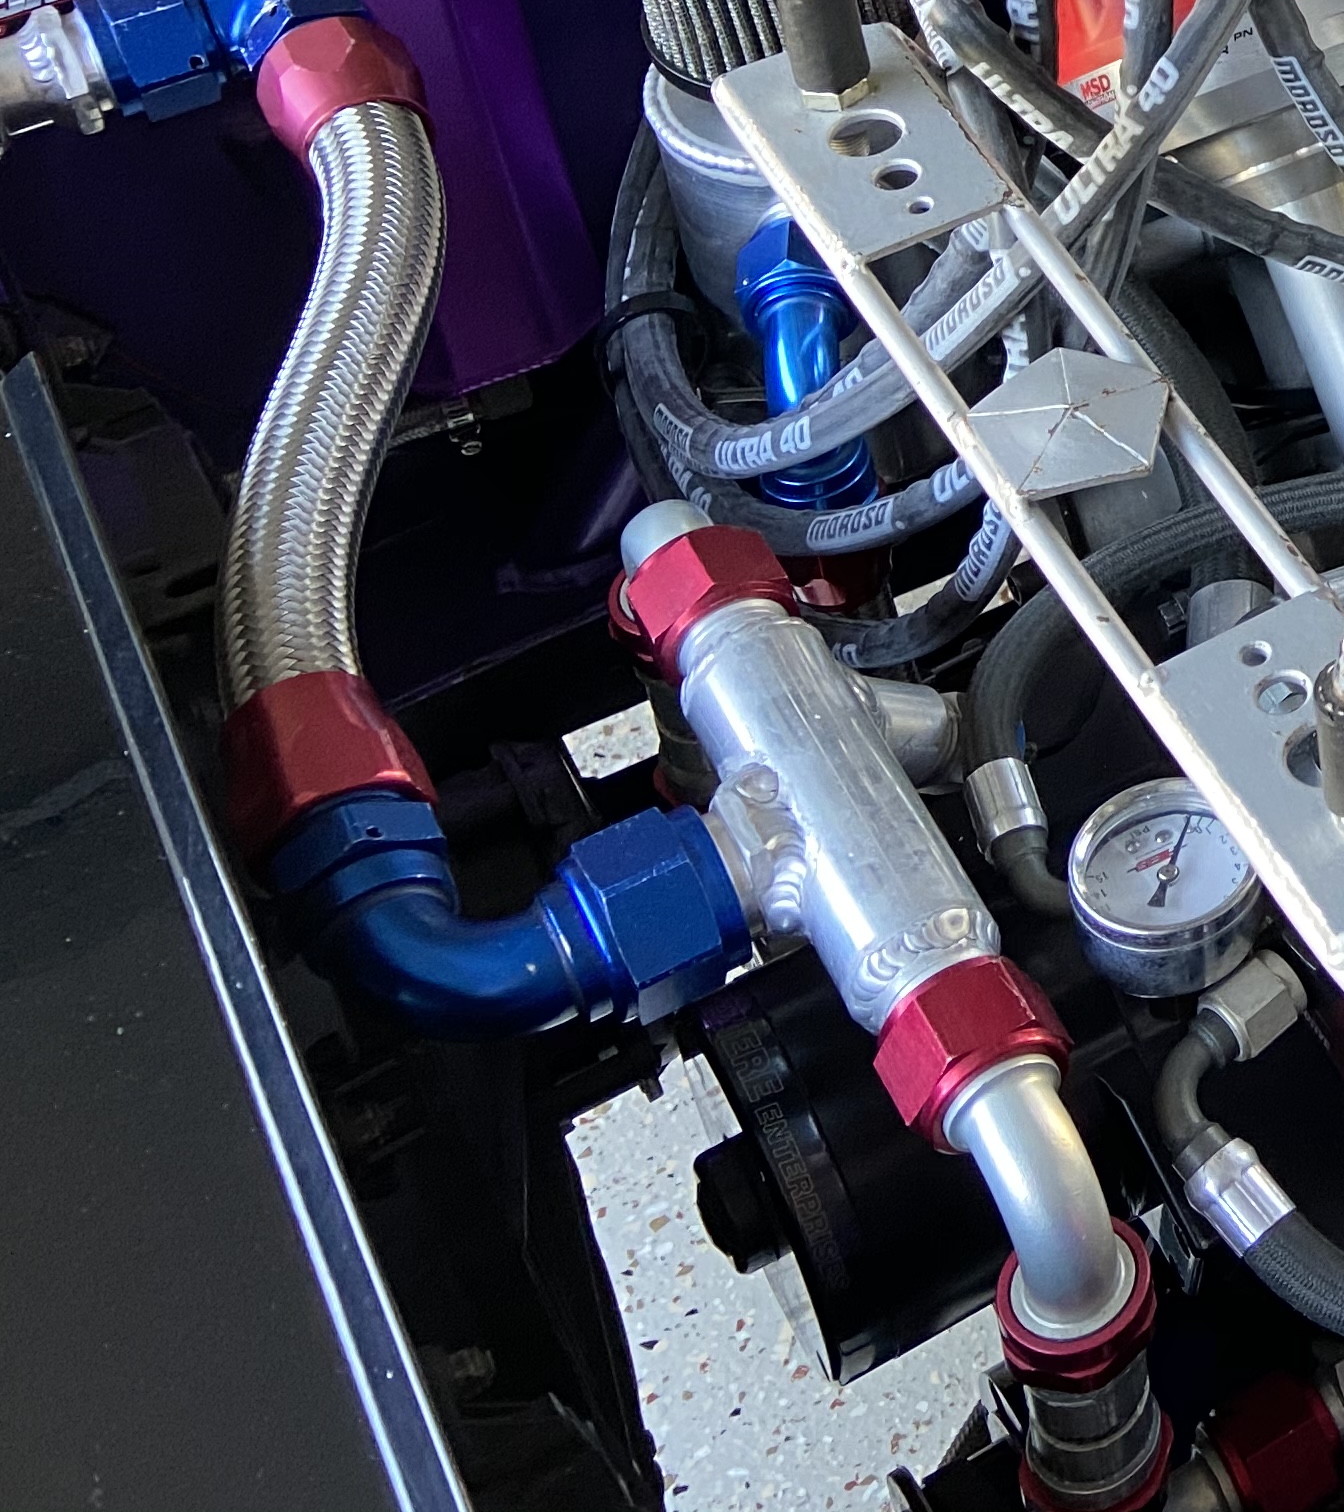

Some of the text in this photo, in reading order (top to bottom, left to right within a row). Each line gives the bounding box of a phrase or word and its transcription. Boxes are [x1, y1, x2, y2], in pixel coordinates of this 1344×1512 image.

[1233, 28, 1255, 42] PN
[1079, 73, 1112, 102] MSD
[714, 430, 778, 472] ULTRA
[779, 414, 812, 455] 40
[806, 498, 895, 552] MOROSO
